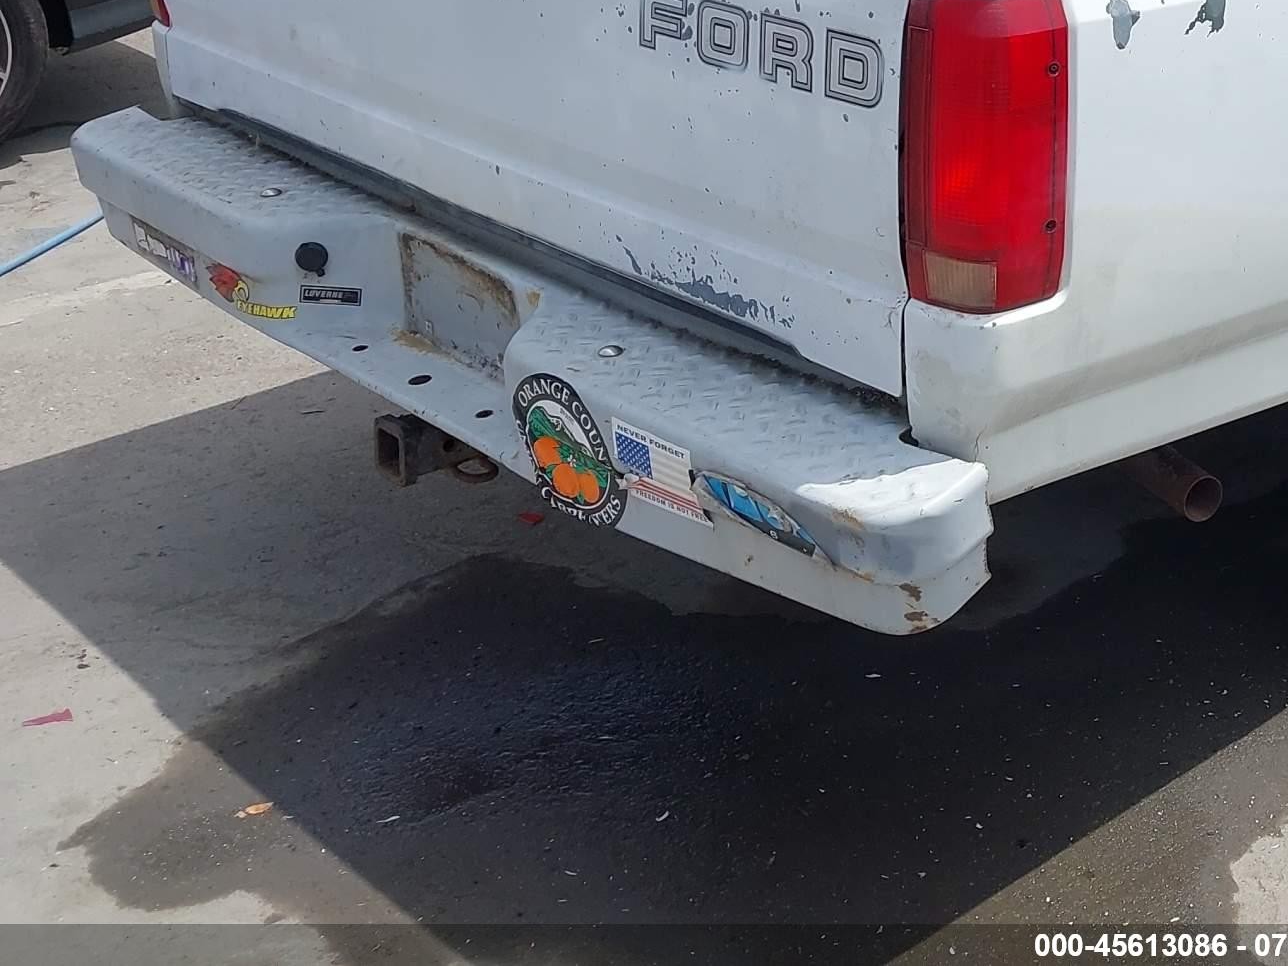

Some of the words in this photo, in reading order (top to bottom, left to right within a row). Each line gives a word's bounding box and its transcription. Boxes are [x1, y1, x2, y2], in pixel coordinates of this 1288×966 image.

[304, 289, 344, 299] LUVERNE
[517, 378, 571, 408] ORANGE
[616, 424, 648, 444] NEVER
[648, 439, 686, 460] FORGET
[636, 490, 667, 507] FREEDOM
[676, 506, 689, 516] NOT
